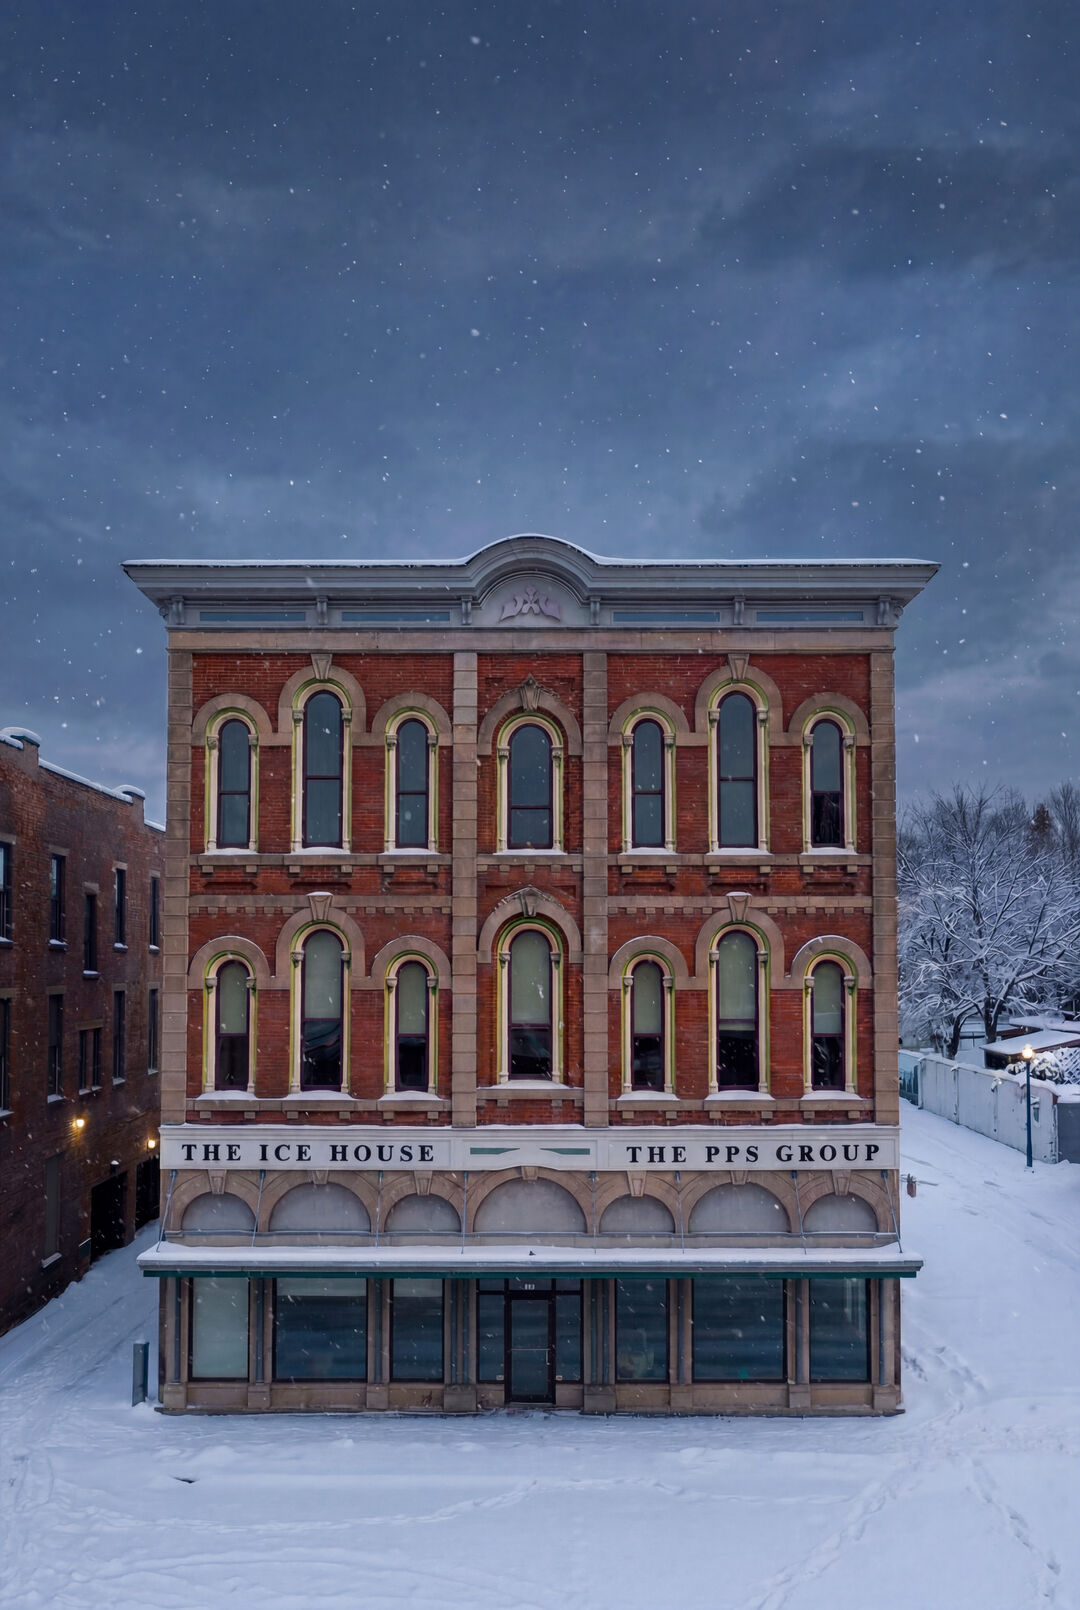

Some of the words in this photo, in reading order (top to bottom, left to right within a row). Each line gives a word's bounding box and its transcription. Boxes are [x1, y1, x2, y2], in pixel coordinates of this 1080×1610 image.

[182, 1144, 241, 1161] THE
[259, 1144, 311, 1161] ICE
[329, 1144, 434, 1162] HOUSE
[626, 1146, 687, 1163] THE
[705, 1145, 759, 1163] PPS
[775, 1144, 880, 1162] GROUP
